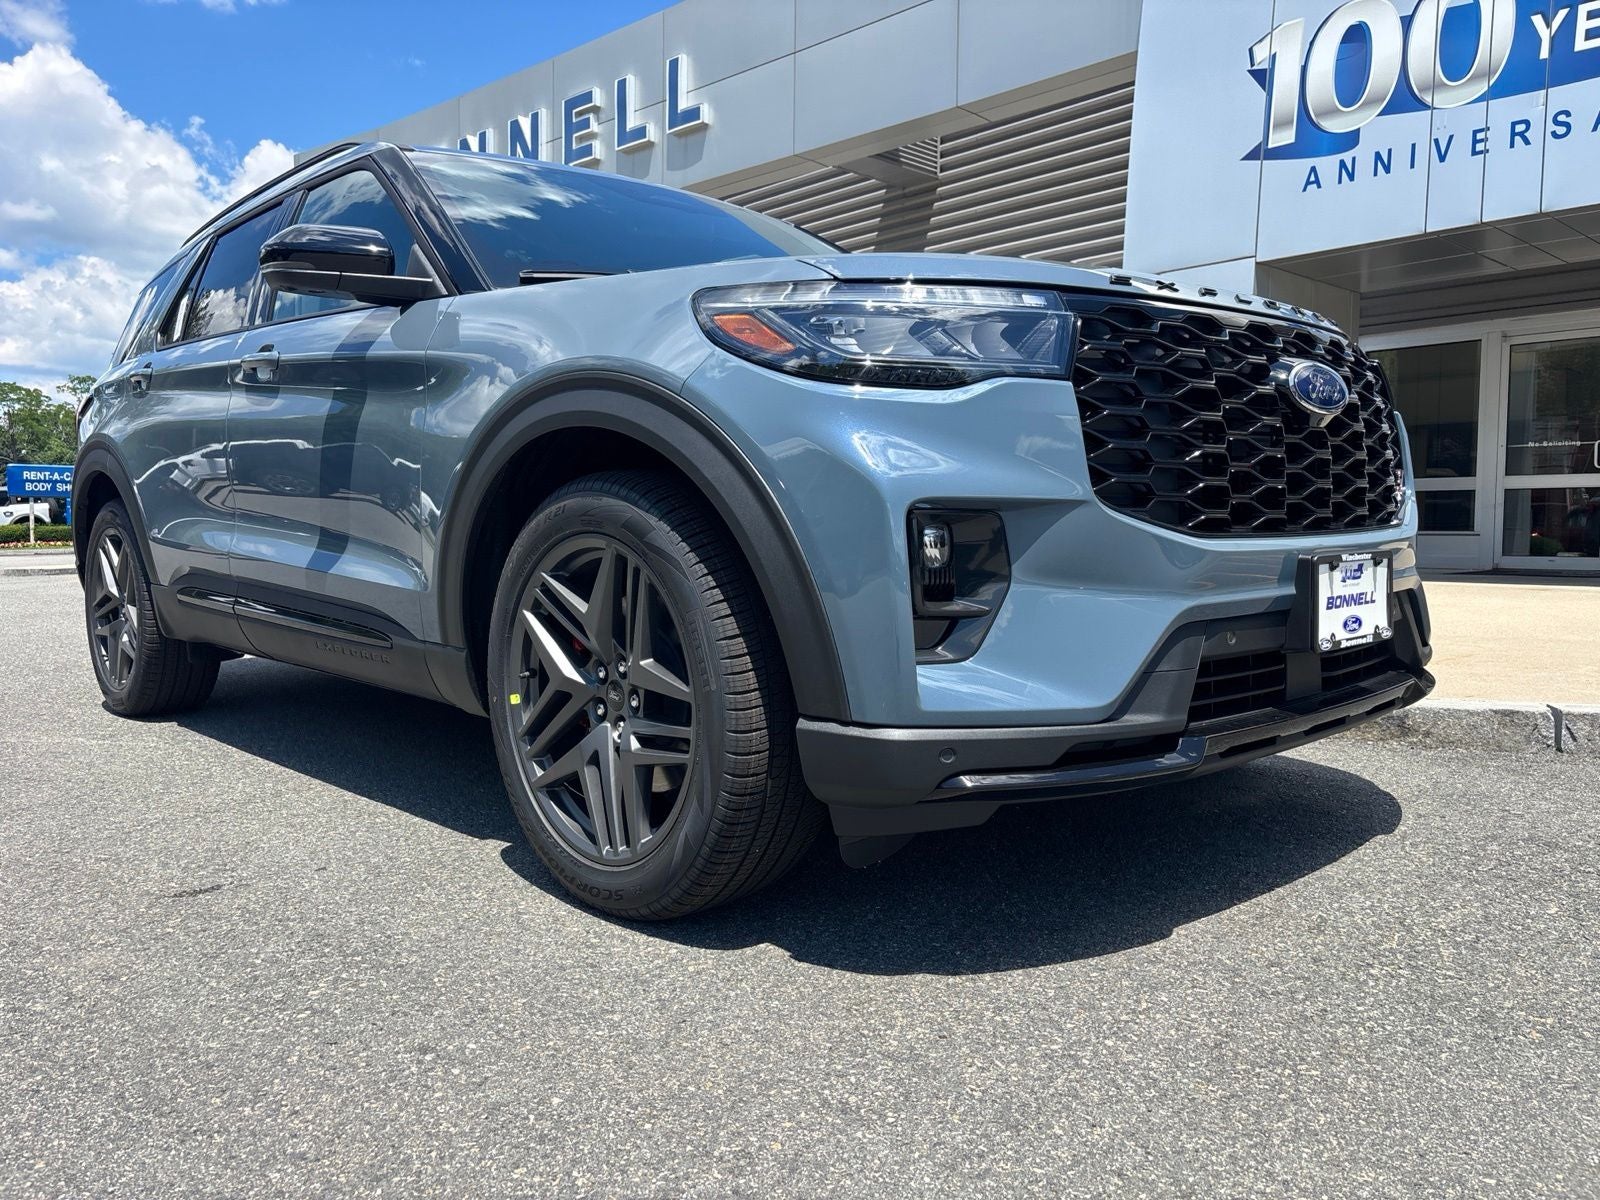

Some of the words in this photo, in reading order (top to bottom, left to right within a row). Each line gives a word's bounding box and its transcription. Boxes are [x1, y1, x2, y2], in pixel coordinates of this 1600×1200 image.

[1248, 0, 1516, 149] 100
[457, 53, 709, 166] NELL
[23, 471, 74, 481] RENT-A-C
[25, 482, 52, 491] BODY
[56, 483, 73, 492] SH
[1341, 553, 1372, 561] Winchester
[1326, 591, 1376, 610] BONNELL
[1340, 634, 1373, 648] Bonnell
